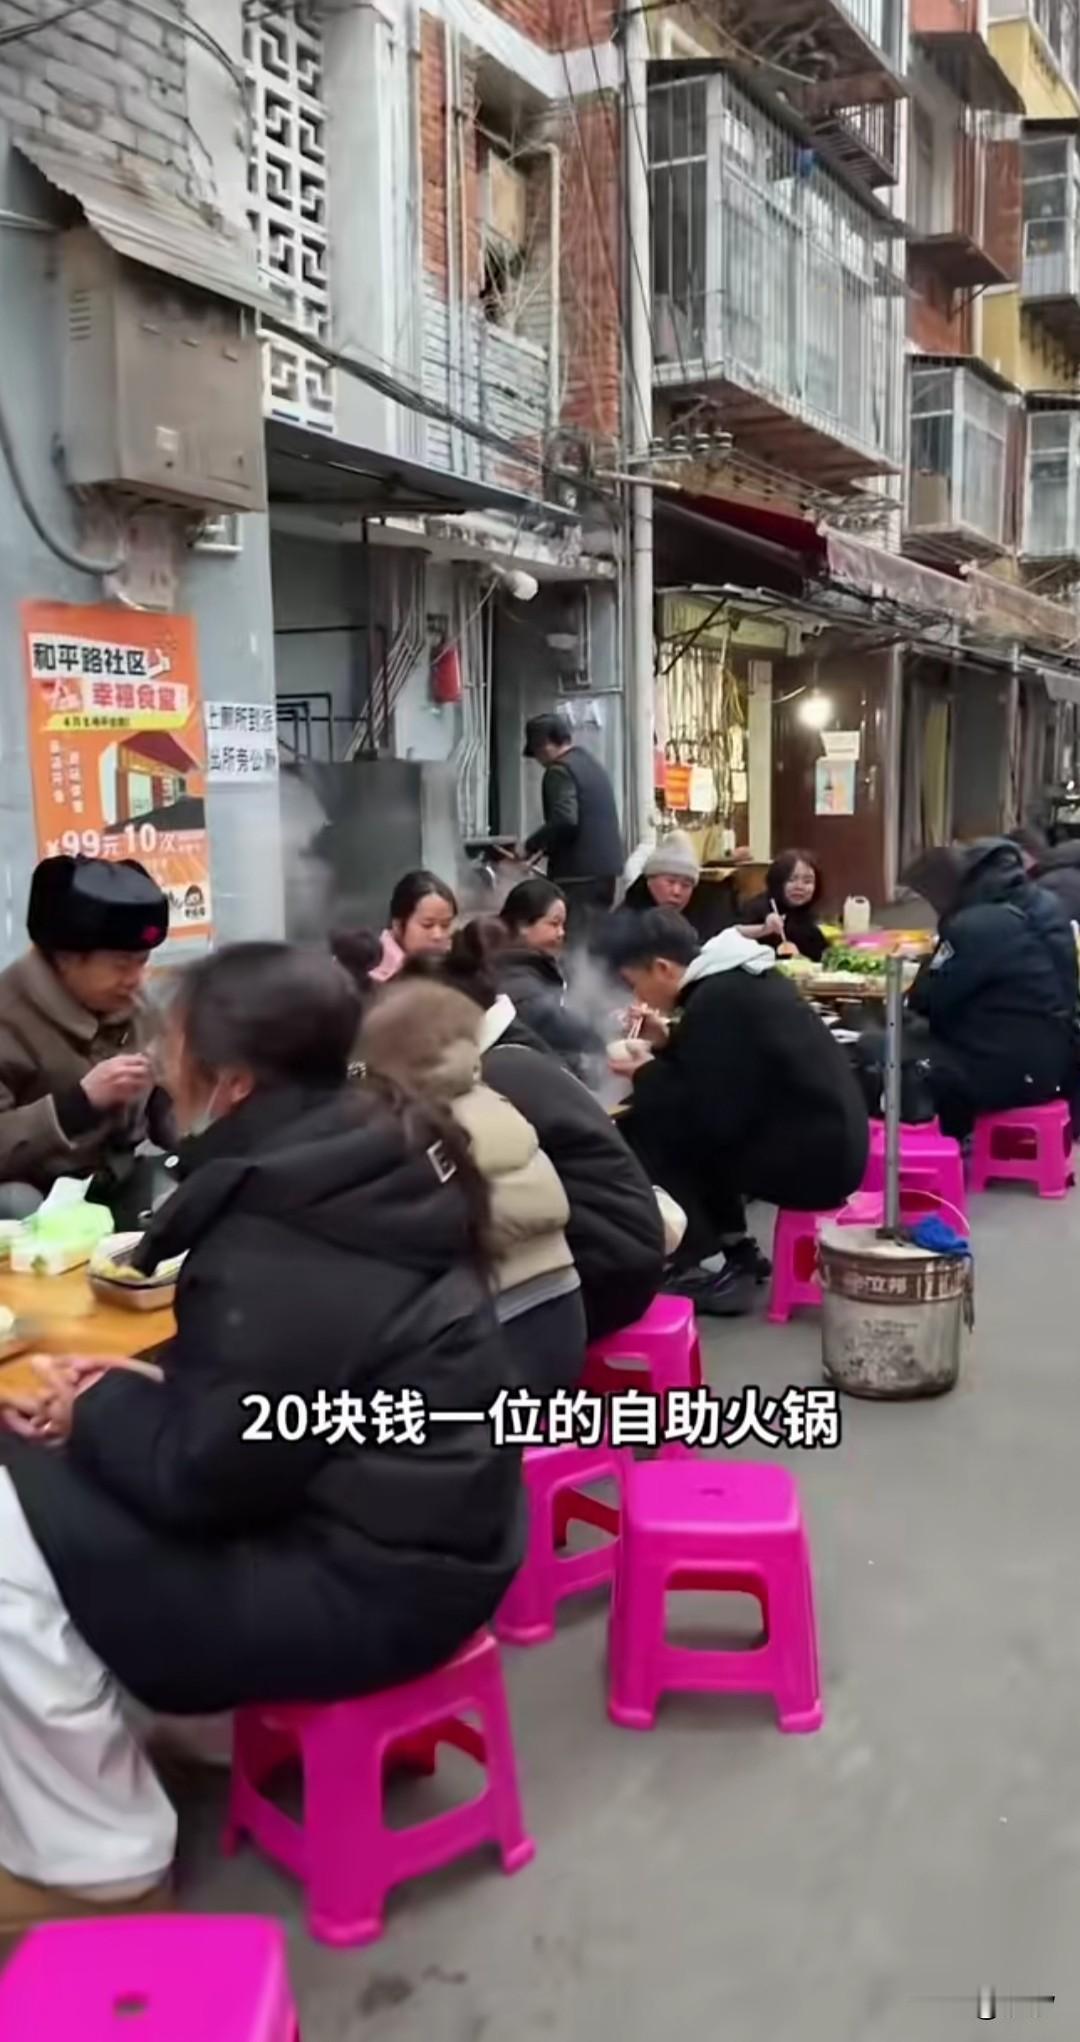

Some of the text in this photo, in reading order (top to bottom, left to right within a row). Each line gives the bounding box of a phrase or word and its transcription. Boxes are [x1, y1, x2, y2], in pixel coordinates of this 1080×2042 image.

[33, 642, 146, 676] 和平路社区
